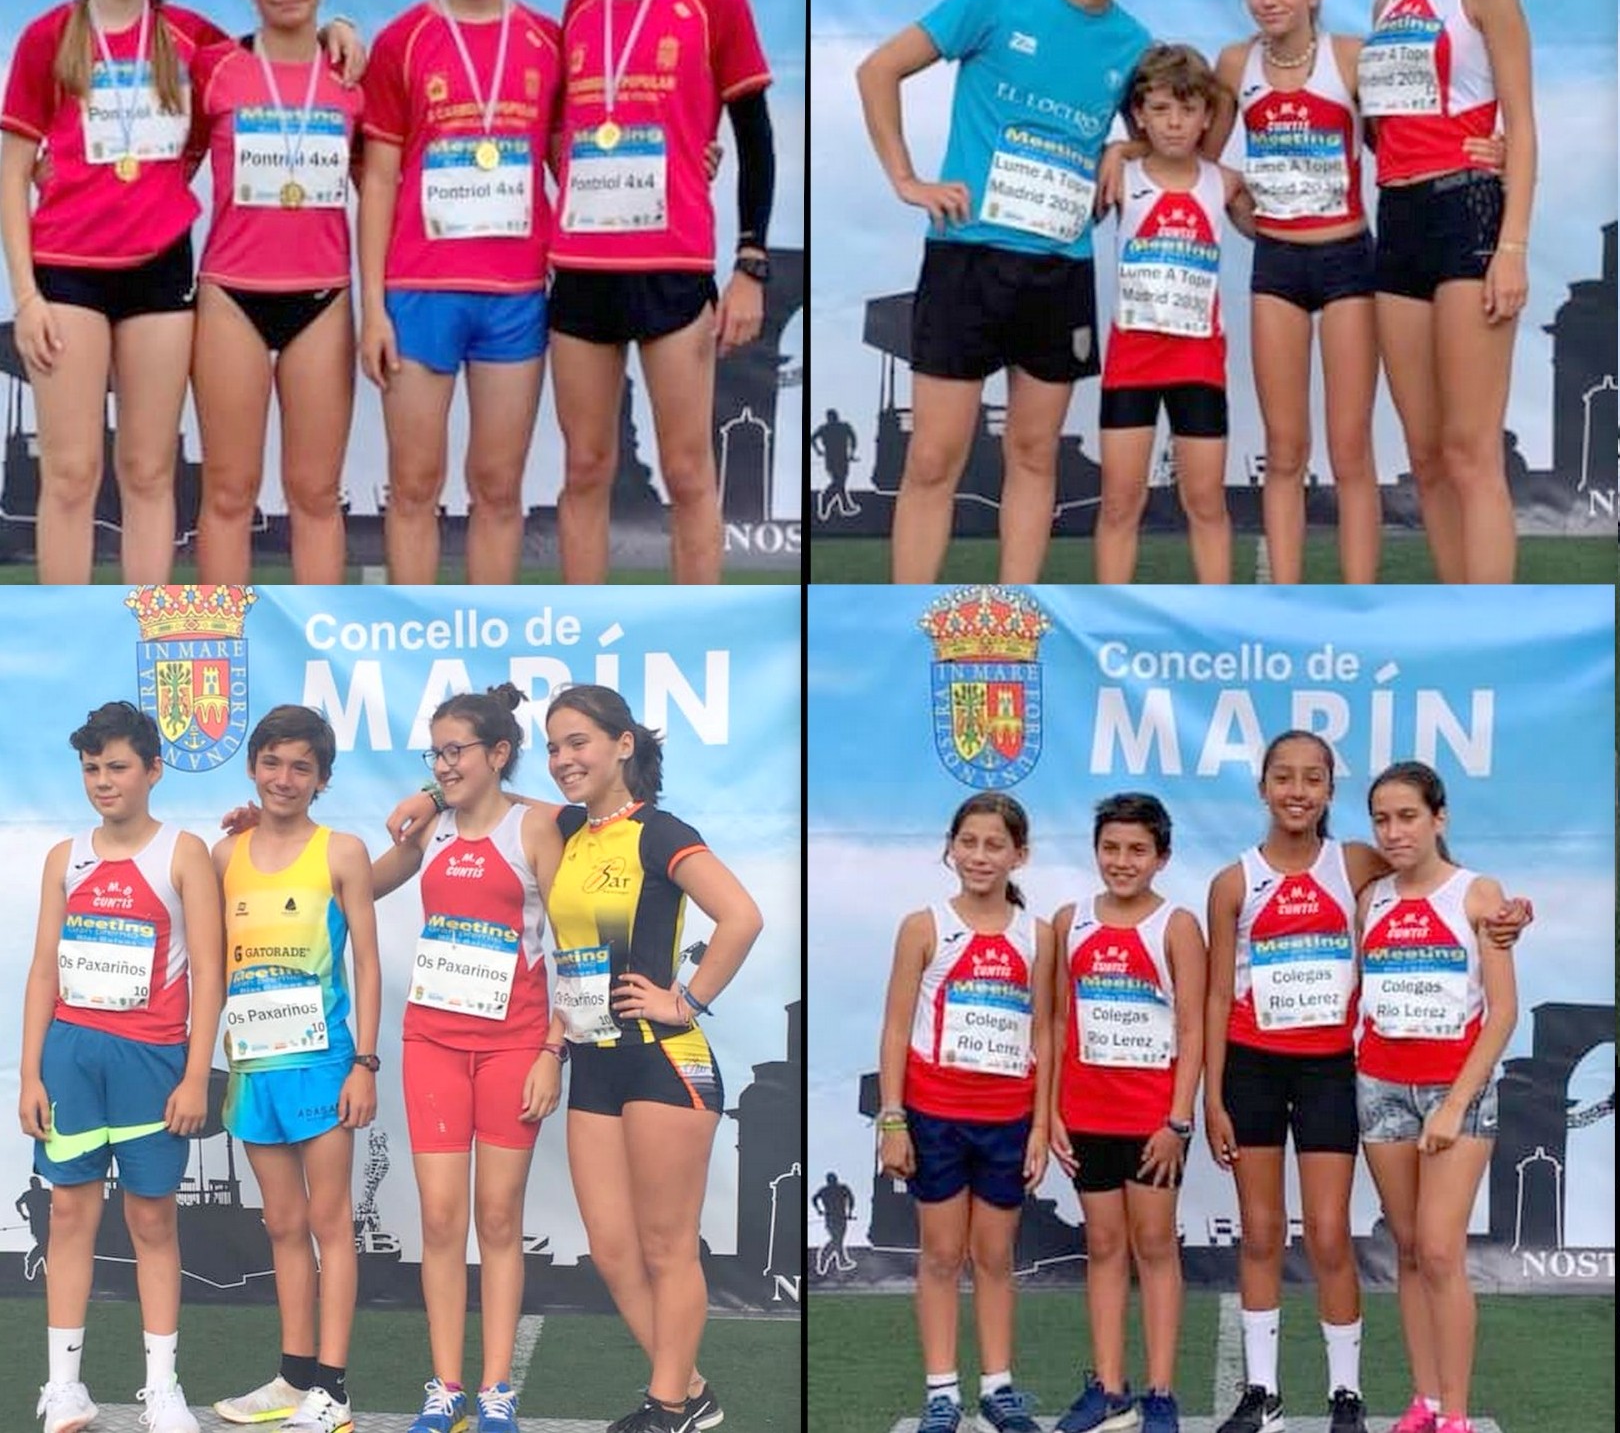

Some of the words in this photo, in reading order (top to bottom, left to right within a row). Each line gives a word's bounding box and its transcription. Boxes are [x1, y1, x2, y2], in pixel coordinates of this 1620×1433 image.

[310, 152, 339, 167] 4x4
[994, 154, 1039, 180] Lume
[1044, 170, 1053, 182] A
[497, 182, 524, 196] 4x4
[624, 174, 654, 189] 4x4
[990, 179, 1044, 204] Madrid
[1120, 264, 1161, 281] Lume
[1166, 268, 1177, 280] A
[1122, 288, 1167, 305] Madrid
[305, 607, 508, 652] Concello
[525, 606, 580, 646] de
[145, 643, 169, 659] IN
[179, 640, 244, 658] MARE
[1099, 640, 1292, 683] Concello
[1307, 643, 1360, 681] de
[66, 915, 154, 938] Meeting
[428, 915, 519, 943] Meeting
[245, 947, 307, 958] GATORADE
[1255, 937, 1348, 954] Meeting
[59, 955, 74, 969] Os
[76, 957, 146, 976] Paxariños
[417, 954, 434, 969] Os
[437, 957, 507, 982] Paxariños
[1273, 969, 1332, 985] Colegas
[134, 986, 148, 997] 10
[1381, 980, 1442, 995] Colegas
[494, 991, 507, 1003] 10
[228, 1012, 244, 1025] Os
[248, 1001, 317, 1022] Paxariños
[1092, 1008, 1149, 1026] Colegas
[312, 1022, 325, 1033] 10
[965, 1012, 1019, 1032] Colegas
